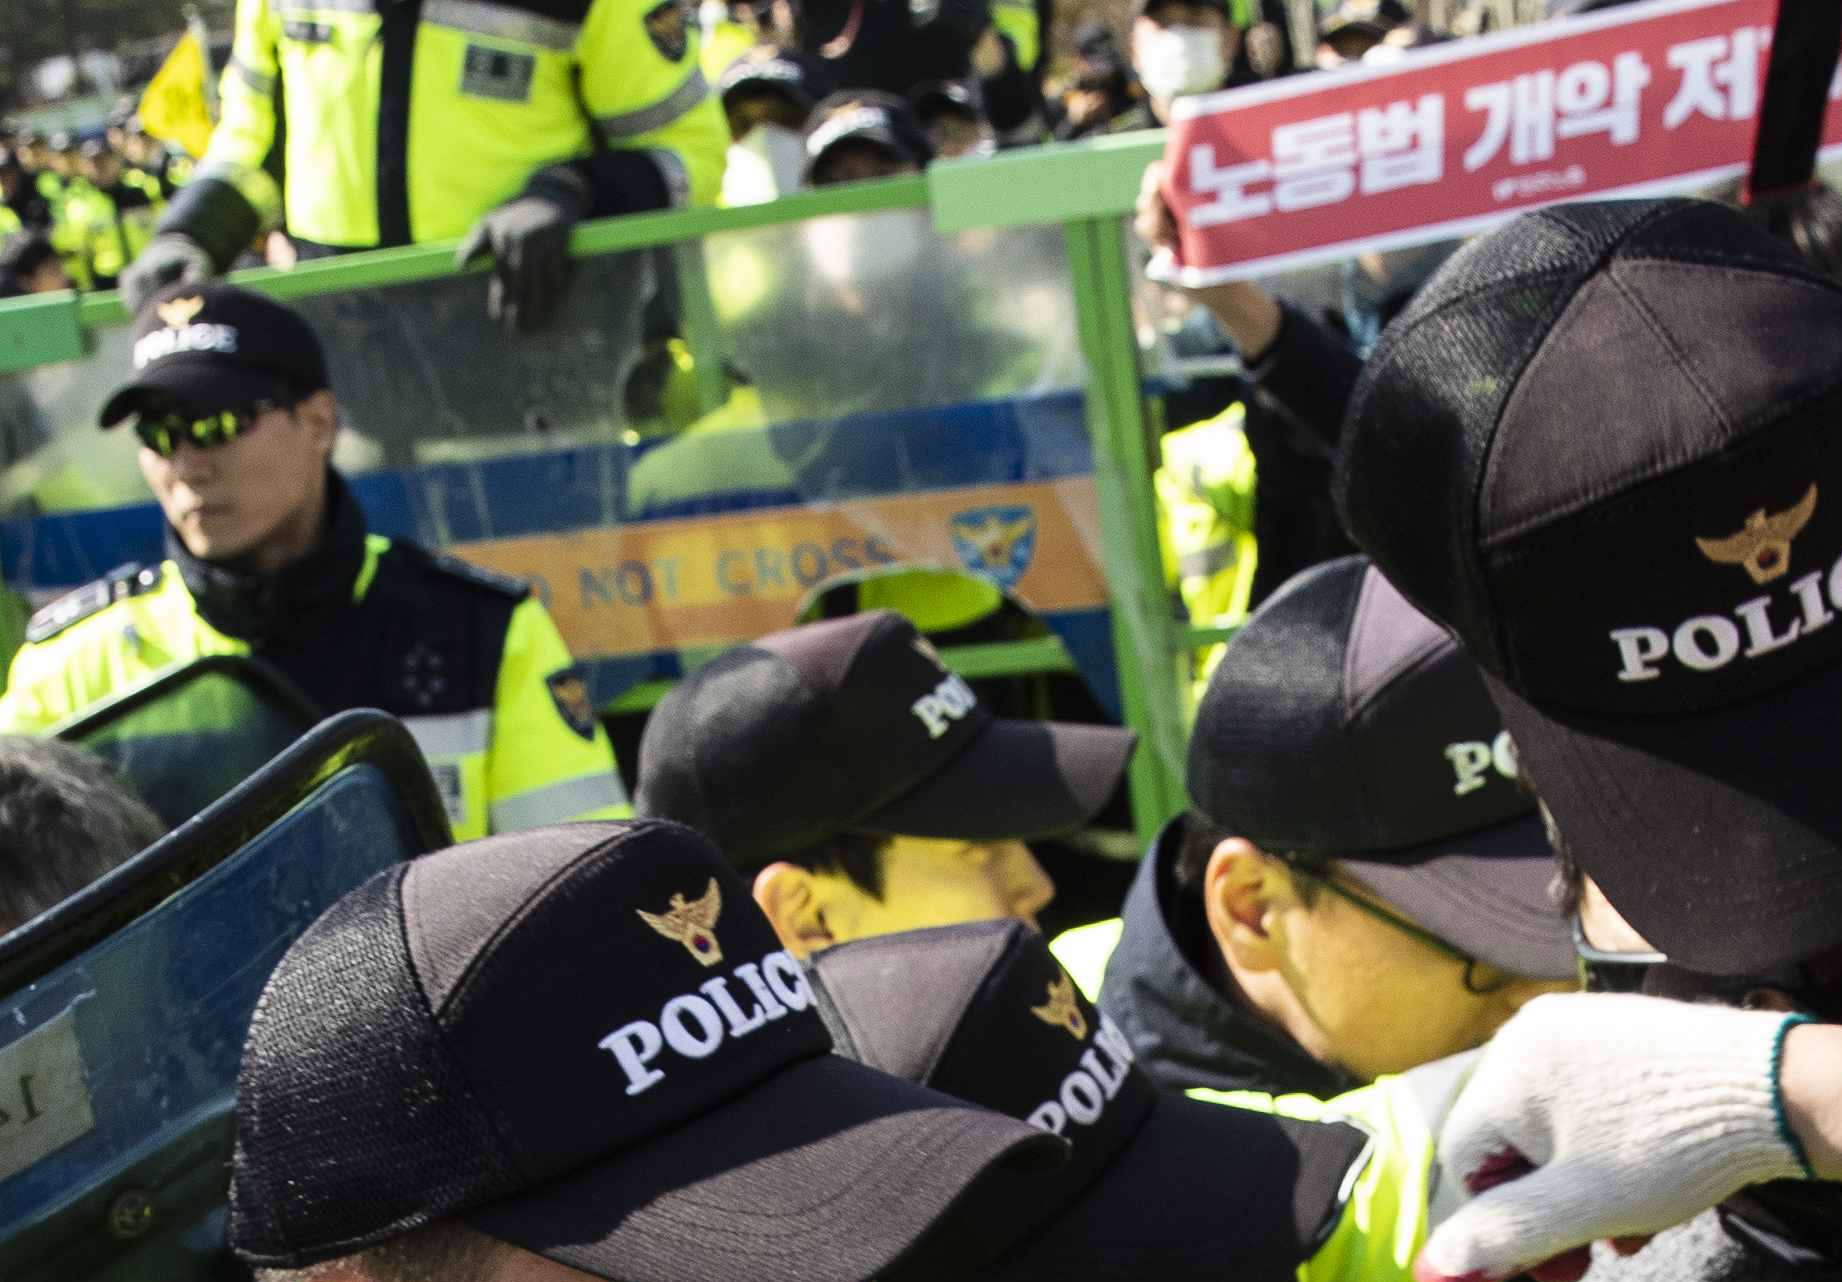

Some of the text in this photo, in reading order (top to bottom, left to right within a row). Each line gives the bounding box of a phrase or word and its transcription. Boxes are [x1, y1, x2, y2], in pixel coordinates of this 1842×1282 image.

[1189, 93, 1446, 229] 노동법
[1463, 50, 1652, 172] 개악
[598, 949, 818, 1095] POLIC
